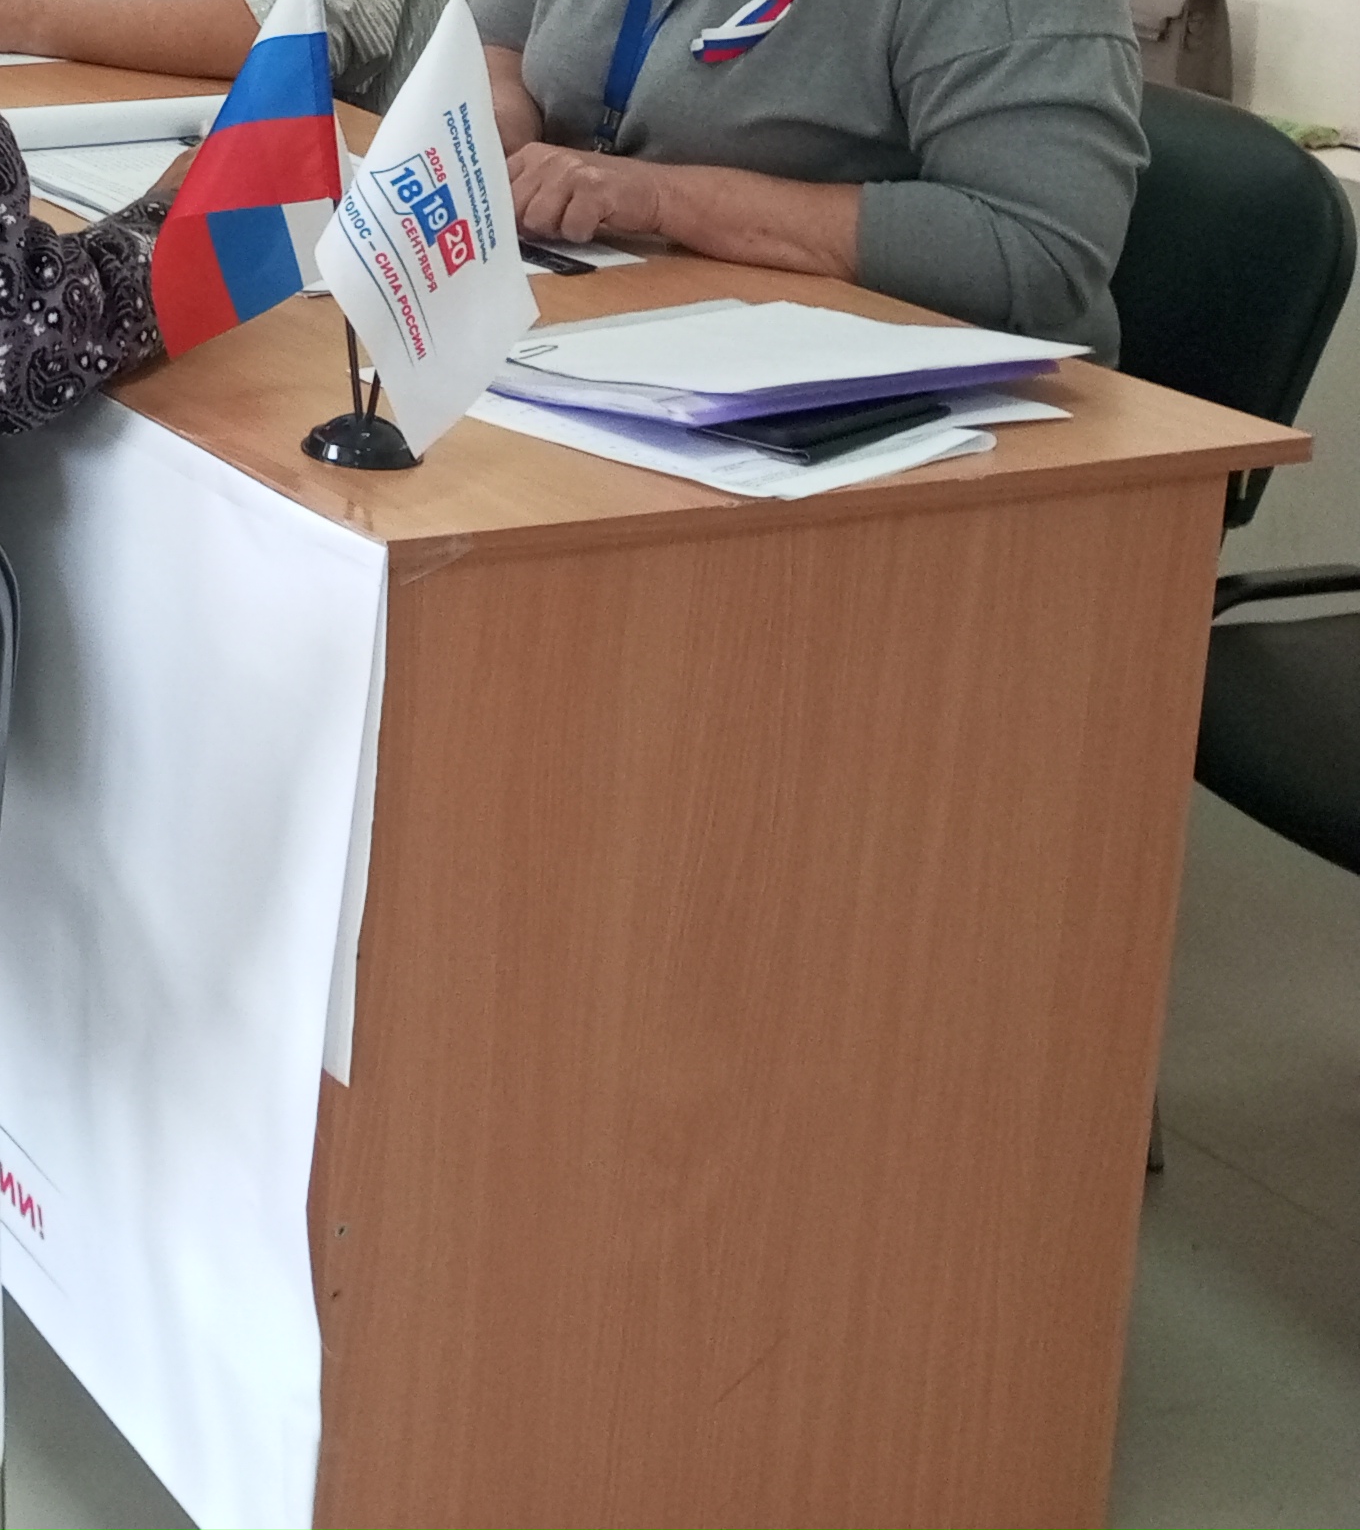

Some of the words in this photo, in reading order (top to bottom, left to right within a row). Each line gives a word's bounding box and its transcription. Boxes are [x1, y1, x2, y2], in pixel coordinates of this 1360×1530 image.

[425, 147, 447, 183] 2026
[390, 166, 423, 203] 18
[423, 195, 448, 231] 19
[444, 224, 468, 266] 20
[401, 217, 438, 293] СЕНТЯБРЯ
[375, 252, 403, 296] СИЛА
[398, 294, 427, 360] РОССИИ!
